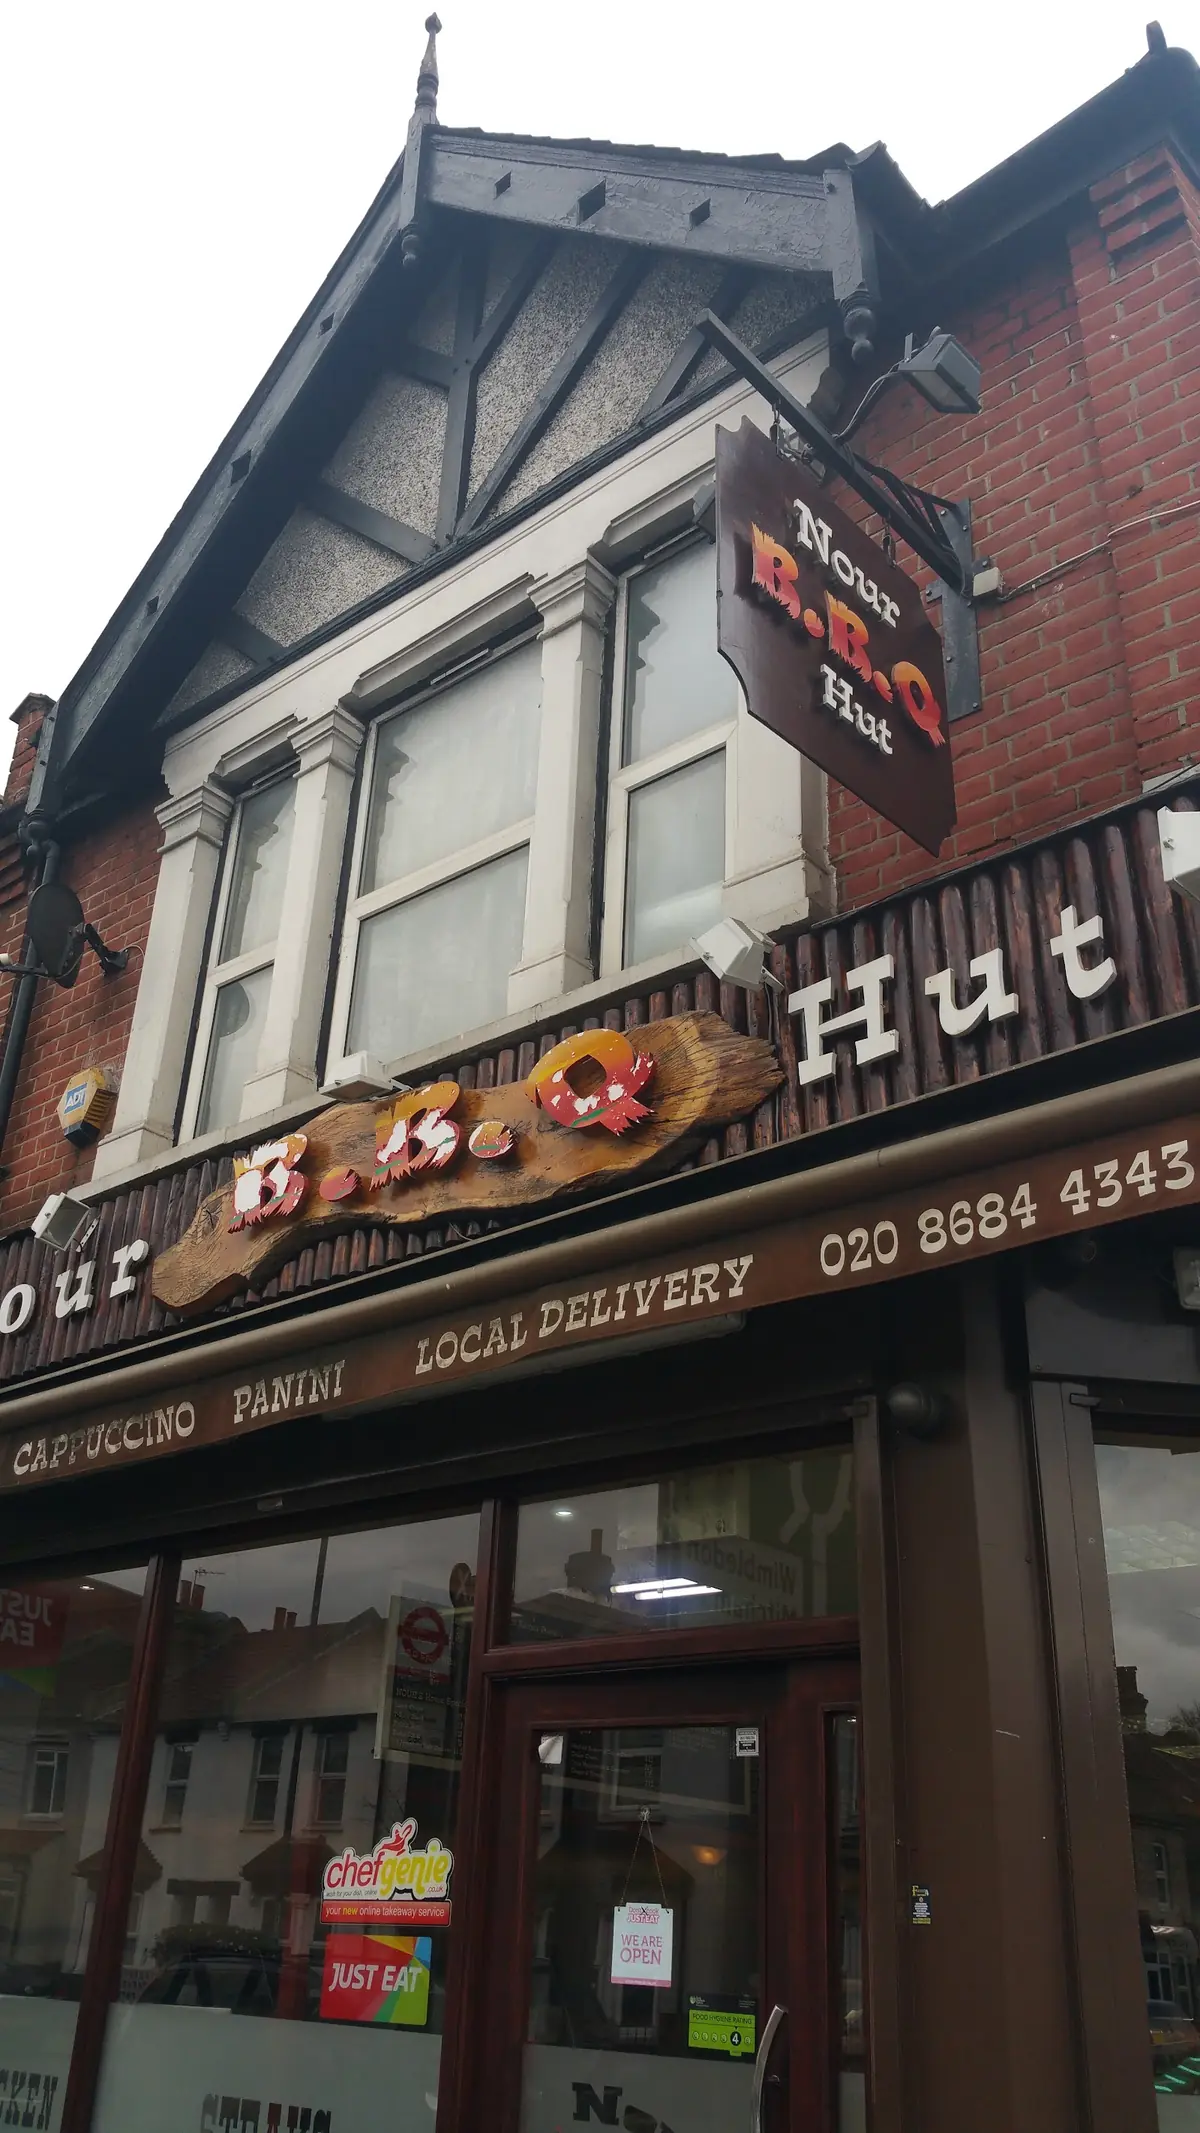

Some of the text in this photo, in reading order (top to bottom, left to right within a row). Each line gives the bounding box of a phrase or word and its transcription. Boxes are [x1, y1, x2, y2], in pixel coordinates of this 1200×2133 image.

[792, 498, 901, 630] Nour
[751, 521, 947, 749] B.B.Q
[820, 662, 894, 756] Hut
[787, 904, 1117, 1087] Hut
[64, 1087, 87, 1110] ADT
[13, 1139, 1196, 1476] CAPPUCCINO PANINI LOCAL DELIVERY 020 8684 4343
[327, 1844, 449, 1896] chefgenie
[325, 1905, 445, 1919] your new online takeaway service
[620, 1947, 662, 1965] OPEN
[621, 1933, 663, 1948] WE ARE
[329, 1962, 423, 1993] JUST EAT
[692, 2012, 709, 2021] FOOD
[732, 2016, 752, 2025] RATING
[731, 2033, 740, 2045] 4
